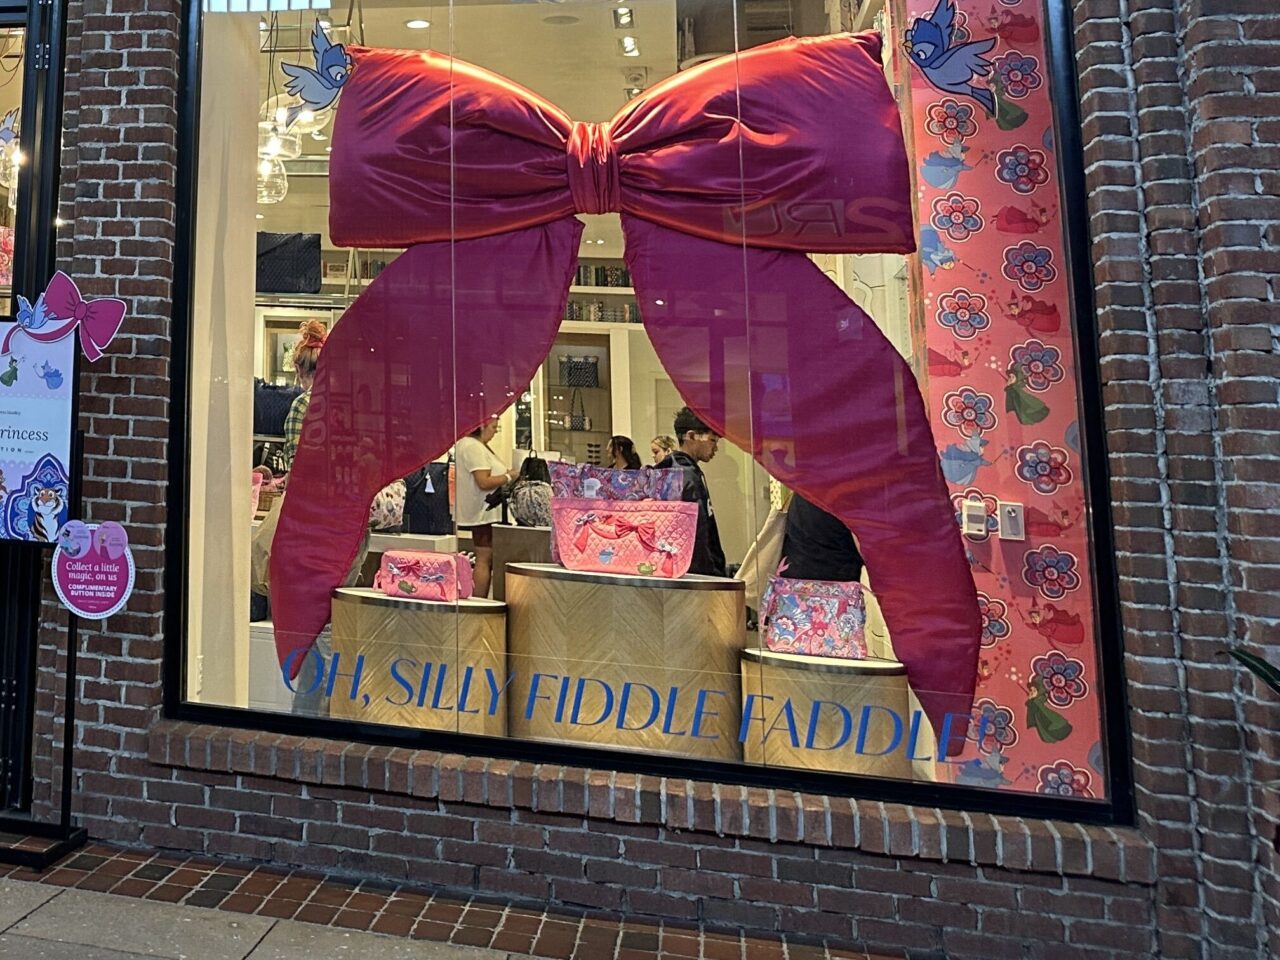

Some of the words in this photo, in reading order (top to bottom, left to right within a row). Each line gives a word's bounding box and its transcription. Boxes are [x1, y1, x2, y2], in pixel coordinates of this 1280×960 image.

[65, 561, 93, 572] Collect
[93, 564, 100, 572] a
[101, 562, 120, 573] little
[68, 571, 94, 582] magic,
[95, 573, 106, 581] on
[67, 583, 118, 592] COMPLIMENTARY
[70, 589, 95, 597] BUTTON
[282, 647, 371, 709] OH,
[385, 657, 516, 716] SILLY
[524, 672, 727, 740] FIDDLE
